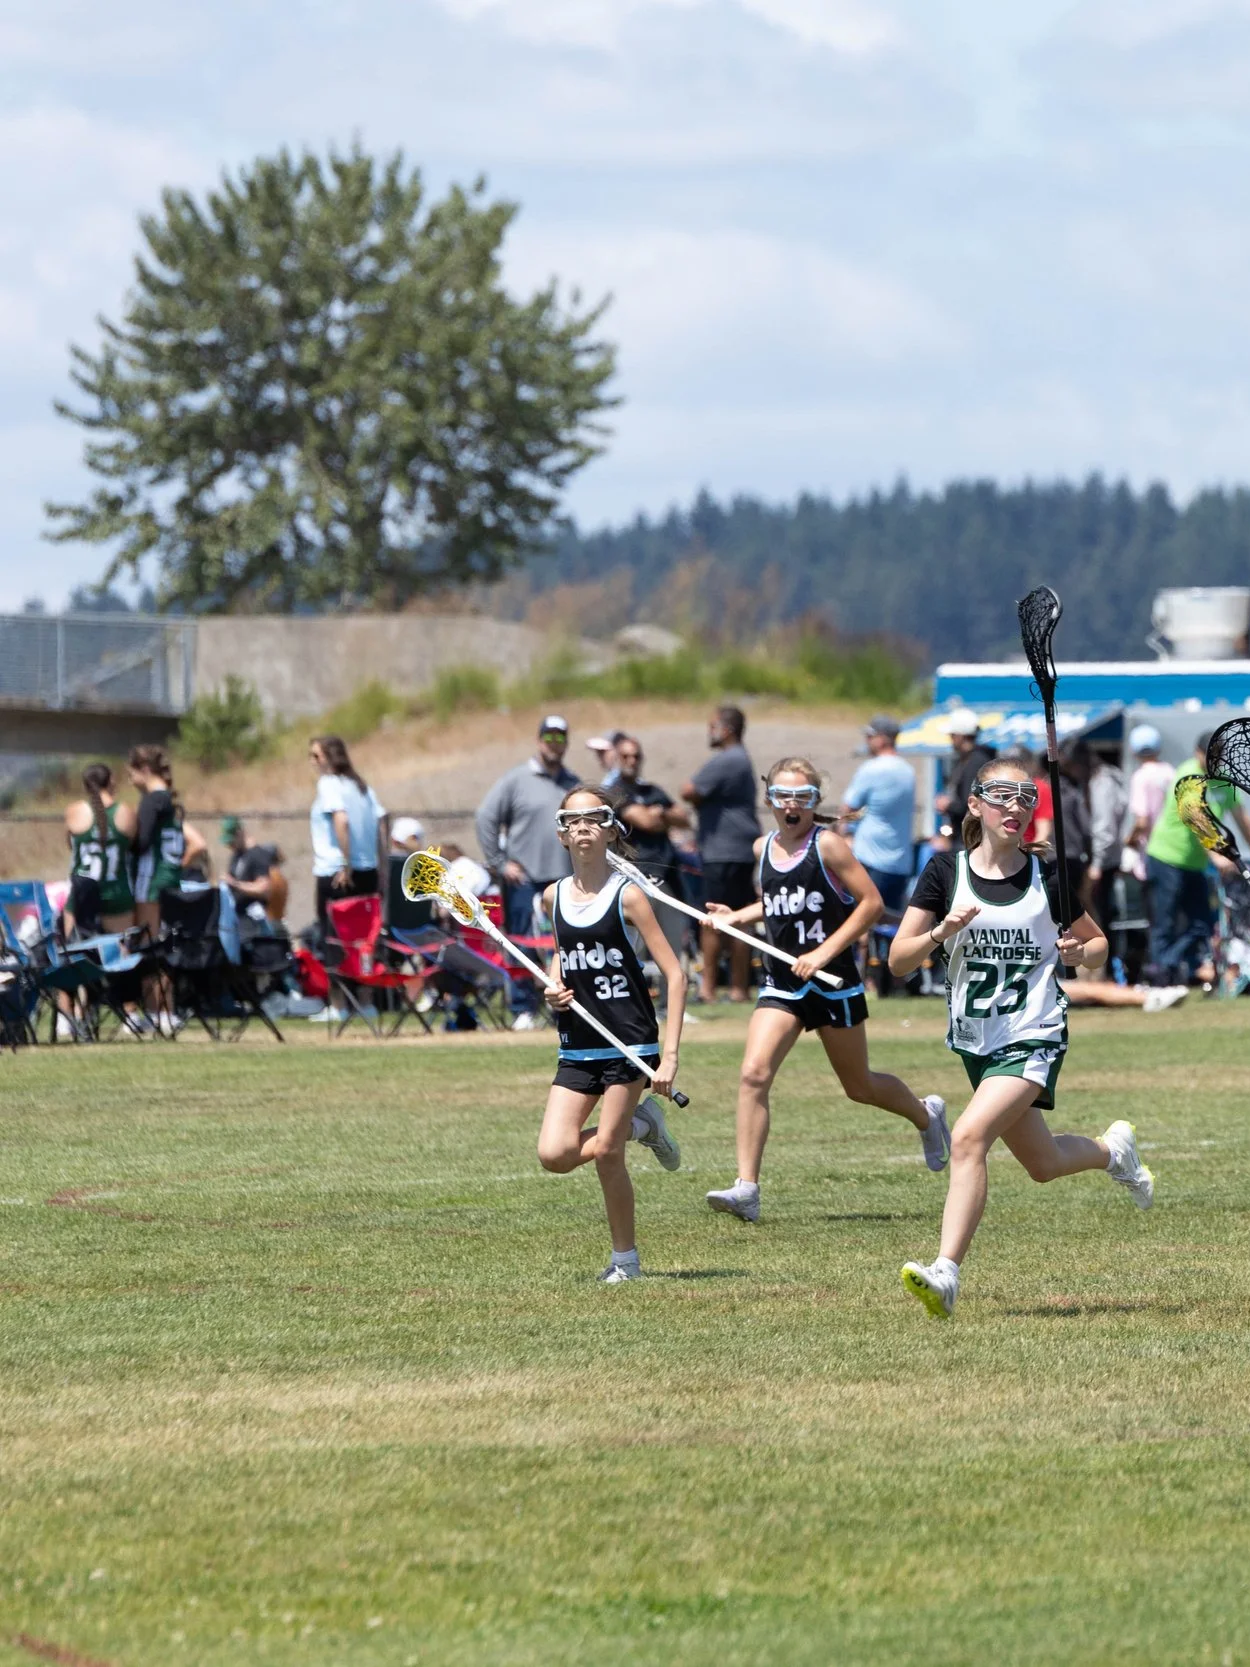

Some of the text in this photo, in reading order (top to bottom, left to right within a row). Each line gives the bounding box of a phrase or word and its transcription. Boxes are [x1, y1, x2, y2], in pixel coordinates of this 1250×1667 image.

[794, 918, 827, 945] 14
[968, 928, 1034, 945] VAND'AL
[962, 945, 1042, 960] LACROSSE
[593, 974, 631, 1000] 32
[964, 961, 1036, 1019] 25
